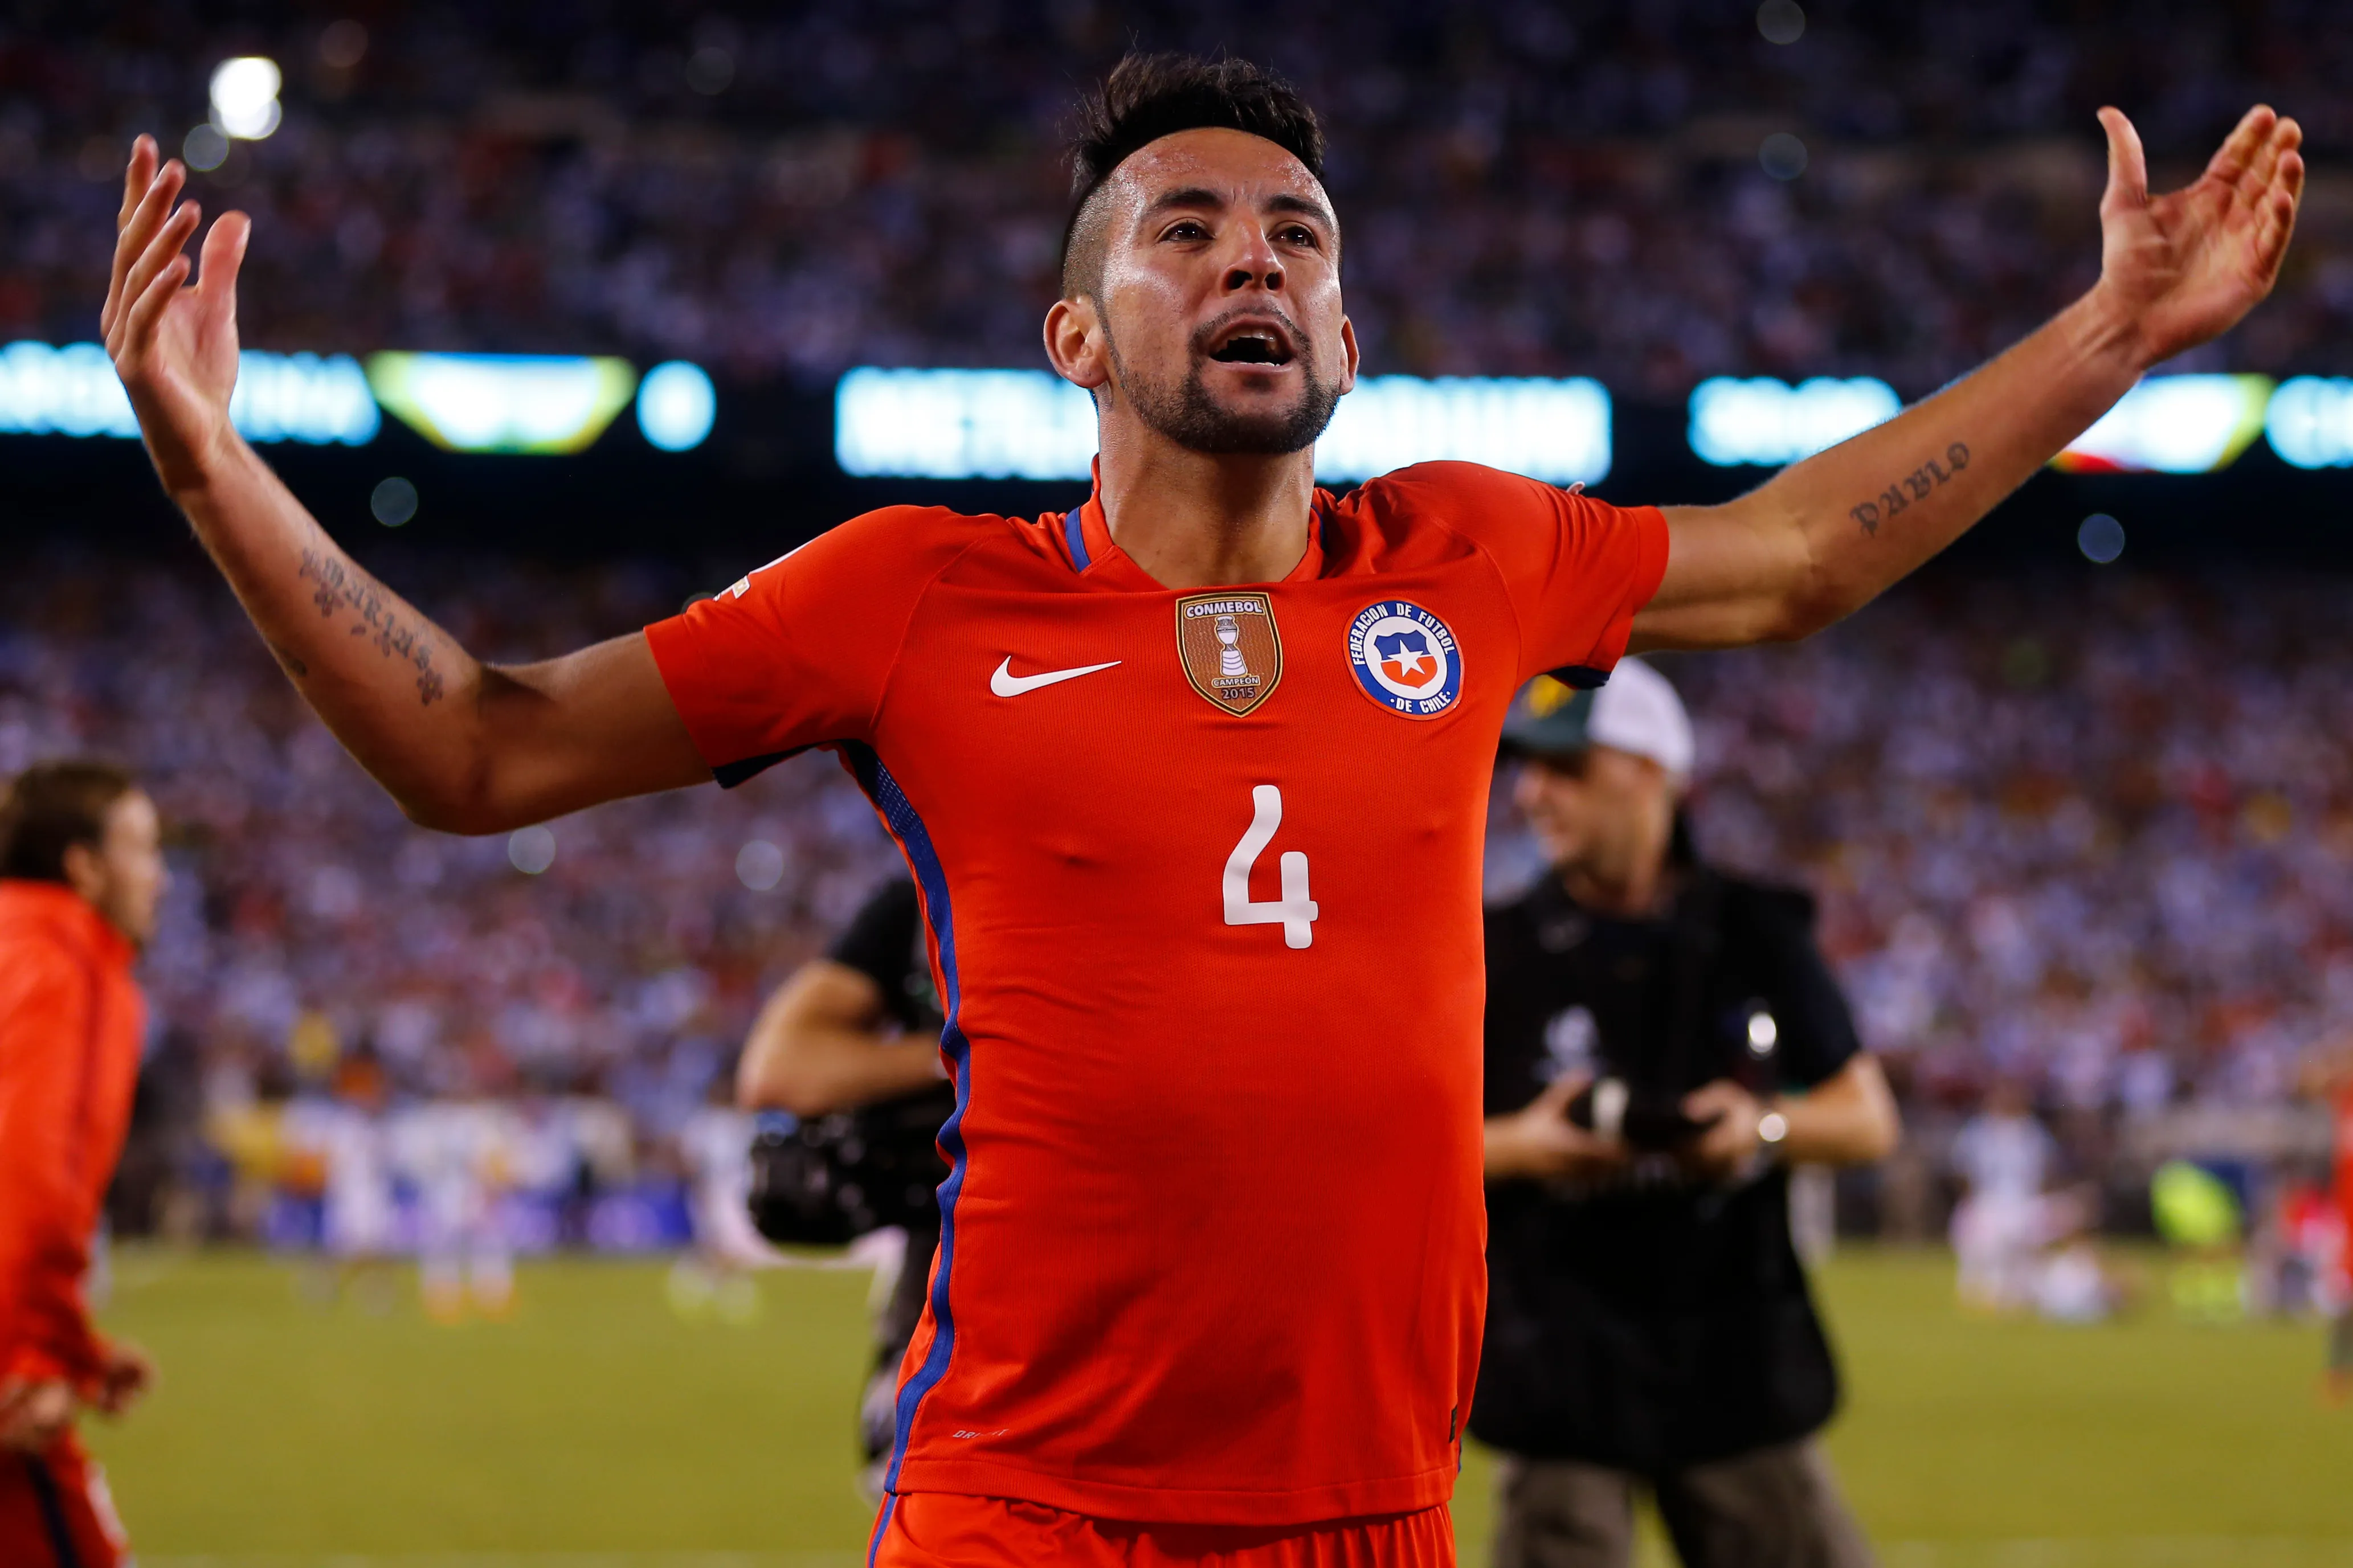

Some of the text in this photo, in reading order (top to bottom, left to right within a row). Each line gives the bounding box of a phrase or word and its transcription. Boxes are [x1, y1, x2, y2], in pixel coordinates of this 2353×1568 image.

[1849, 442, 1970, 538] PABLO
[1186, 601, 1263, 618] CONMEBOL
[1350, 603, 1456, 665] FEDERACION DE FUTBOL
[1222, 687, 1255, 699] 2015
[1396, 691, 1452, 714] DE CHILE
[1222, 784, 1319, 949] 4
